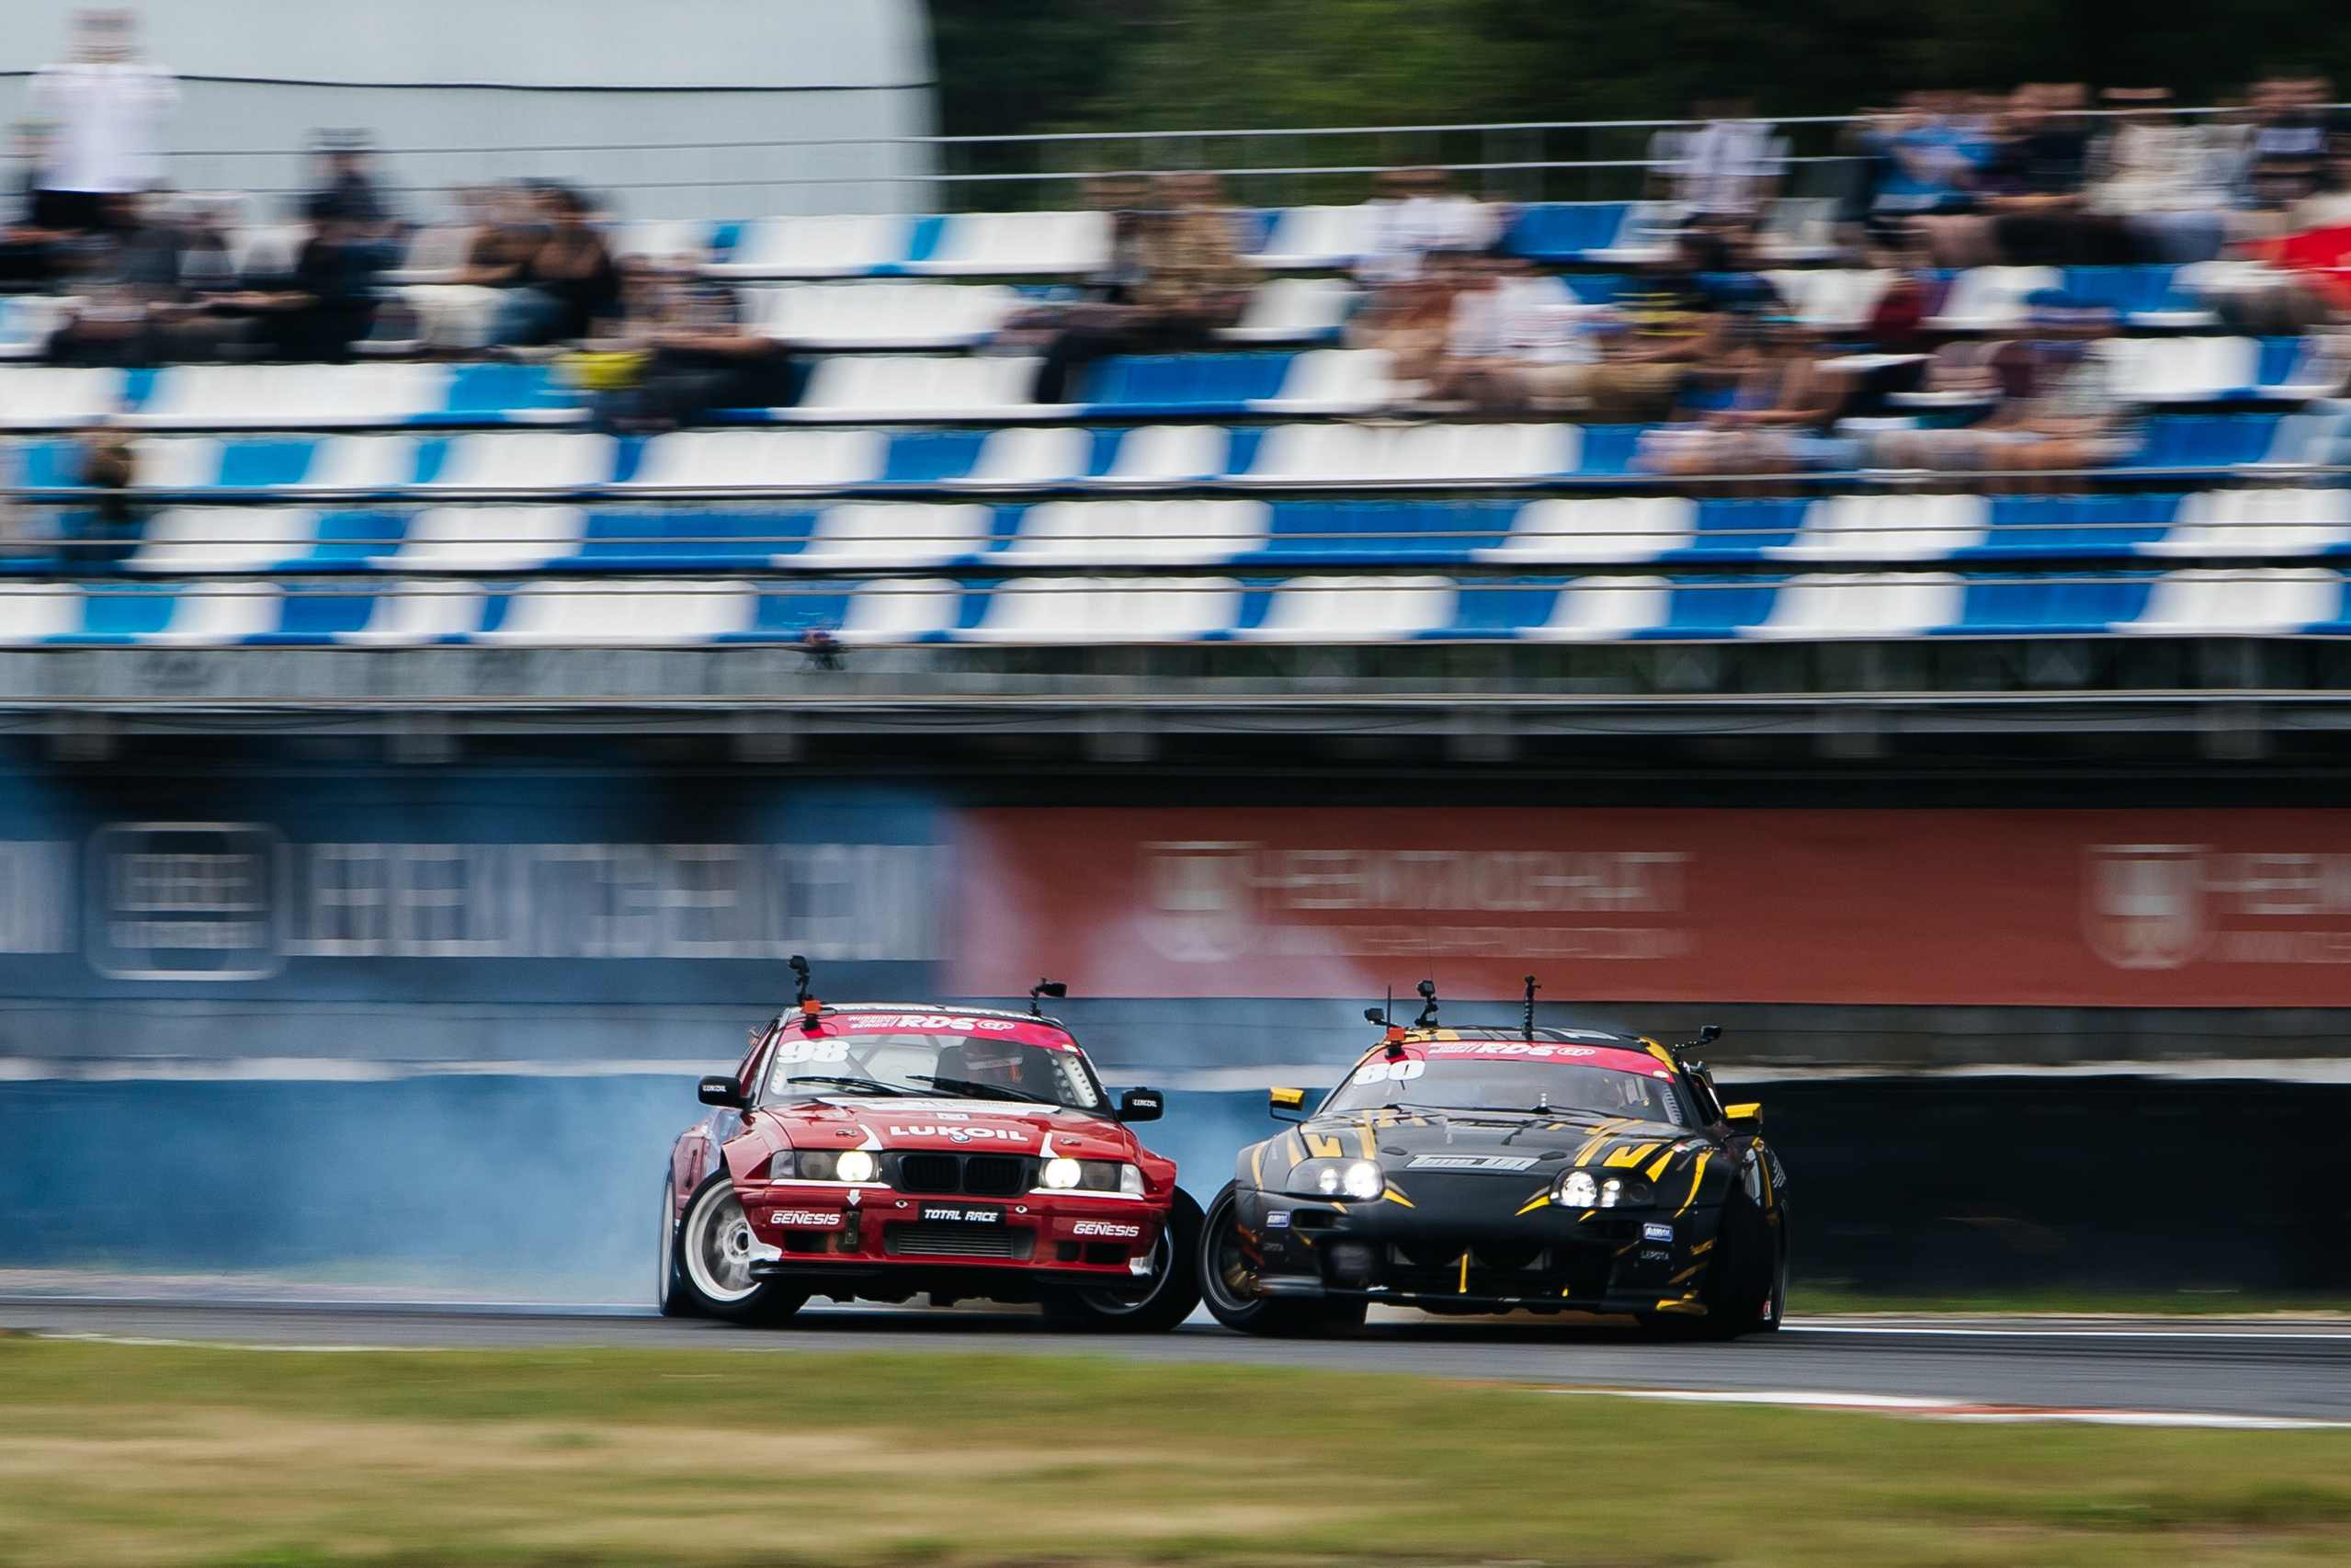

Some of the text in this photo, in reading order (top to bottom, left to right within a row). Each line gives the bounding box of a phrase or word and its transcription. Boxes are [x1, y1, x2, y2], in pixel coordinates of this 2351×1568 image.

[898, 1015, 978, 1029] RDS
[978, 1020, 1015, 1030] GP
[778, 1040, 851, 1064] 98
[1476, 1043, 1558, 1055] RDS
[1352, 1059, 1426, 1085] 80
[701, 1085, 727, 1093] LUKOIL
[1131, 1098, 1158, 1108] LUKOIL
[889, 1125, 1029, 1142] LUKOIL
[770, 1212, 841, 1225] GENESIS
[925, 1209, 999, 1222] TOTAL RACE
[1073, 1223, 1140, 1237] GENESIS
